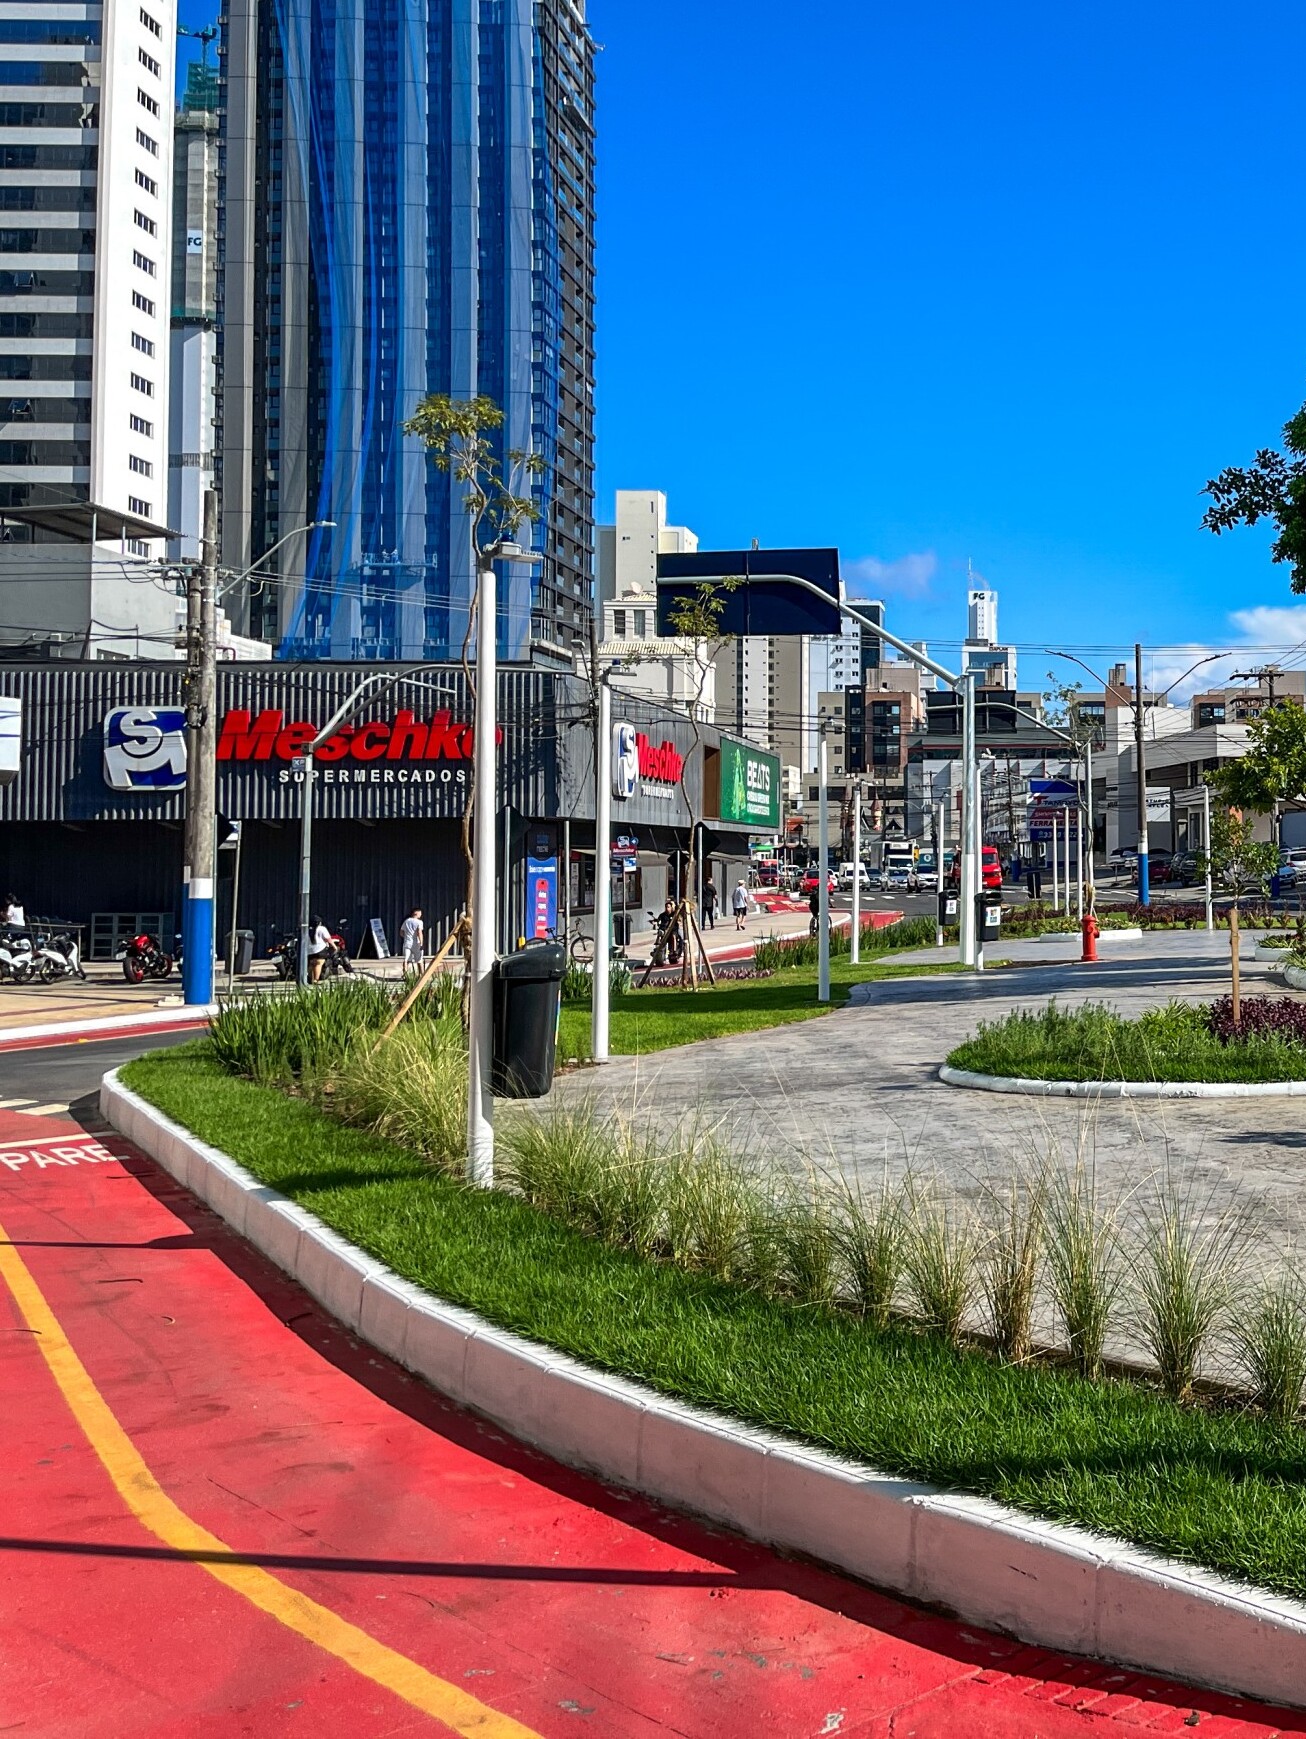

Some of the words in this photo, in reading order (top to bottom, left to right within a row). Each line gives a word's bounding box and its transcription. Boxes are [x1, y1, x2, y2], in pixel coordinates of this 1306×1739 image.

[187, 237, 202, 246] FG
[973, 592, 985, 600] FG
[279, 769, 467, 783] SUPERMERCADOS
[0, 1144, 130, 1171] PARE
